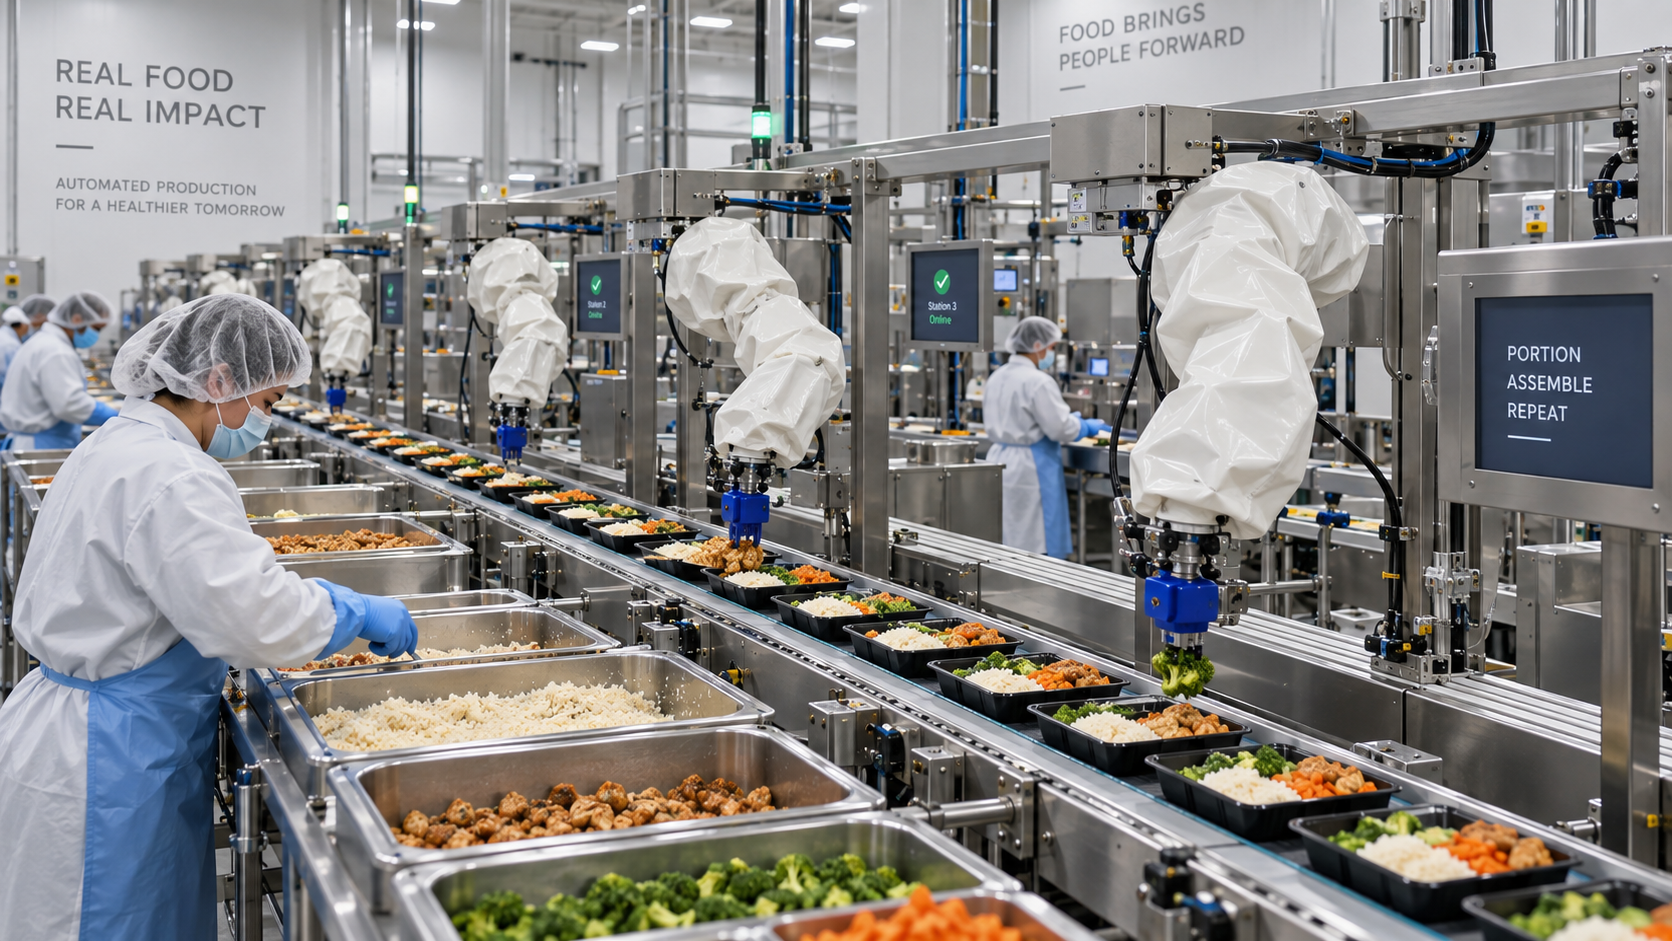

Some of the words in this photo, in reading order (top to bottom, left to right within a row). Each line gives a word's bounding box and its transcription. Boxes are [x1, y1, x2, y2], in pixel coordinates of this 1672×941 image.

[1060, 19, 1115, 44] FOOD
[1124, 2, 1206, 33] BRINGS
[1060, 44, 1131, 71] PEOPLE
[1139, 26, 1245, 59] FORWARD
[56, 59, 132, 87] REAL
[145, 64, 234, 93] FOOD
[56, 95, 133, 123] REAL
[146, 99, 267, 129] IMPACT
[55, 176, 151, 193] AUTOMATED
[156, 180, 257, 197] PRODUCTION
[55, 198, 86, 211] FOR
[90, 199, 102, 212] A
[107, 199, 189, 215] HEALTHIER
[195, 202, 286, 217] TOMORROW
[927, 301, 951, 311] Station
[952, 301, 958, 311] 3
[929, 314, 952, 325] Online
[1507, 345, 1581, 363] PORTION
[1507, 374, 1593, 394] ASSEMBLE
[1507, 402, 1568, 422] REPEAT
